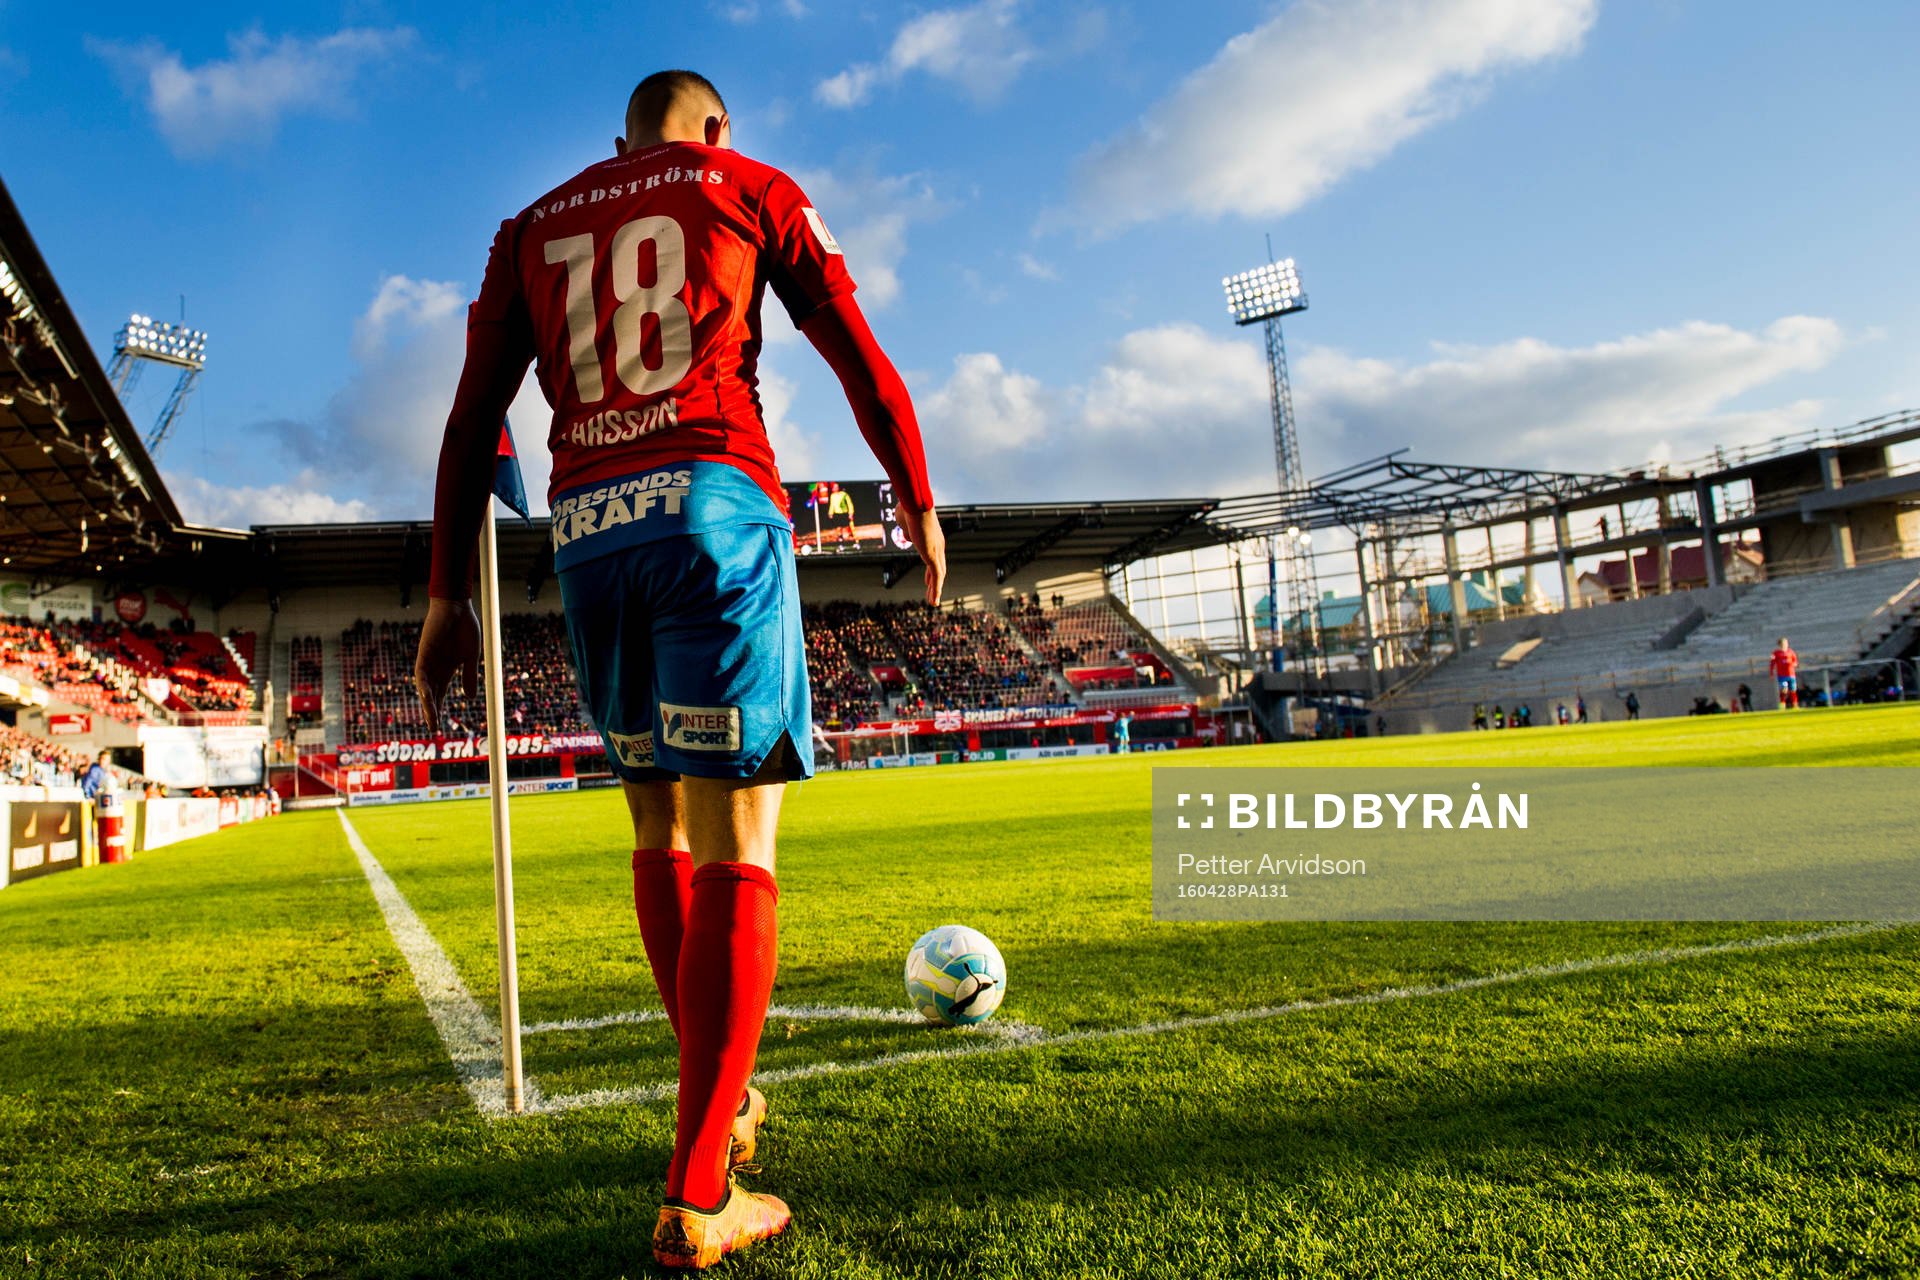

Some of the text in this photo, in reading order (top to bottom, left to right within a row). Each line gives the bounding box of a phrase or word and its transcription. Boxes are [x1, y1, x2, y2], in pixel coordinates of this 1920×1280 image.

[532, 166, 724, 223] NORDSTRÖMS
[544, 215, 692, 404] 18
[562, 397, 679, 447] ARSSON
[552, 470, 692, 524] ÖRESUNDS
[552, 487, 690, 553] KRAFT
[627, 736, 654, 753] INTE
[681, 713, 728, 729] INTER
[682, 730, 729, 745] SPORT
[377, 740, 437, 762] SÖDRA
[505, 736, 544, 755] 985
